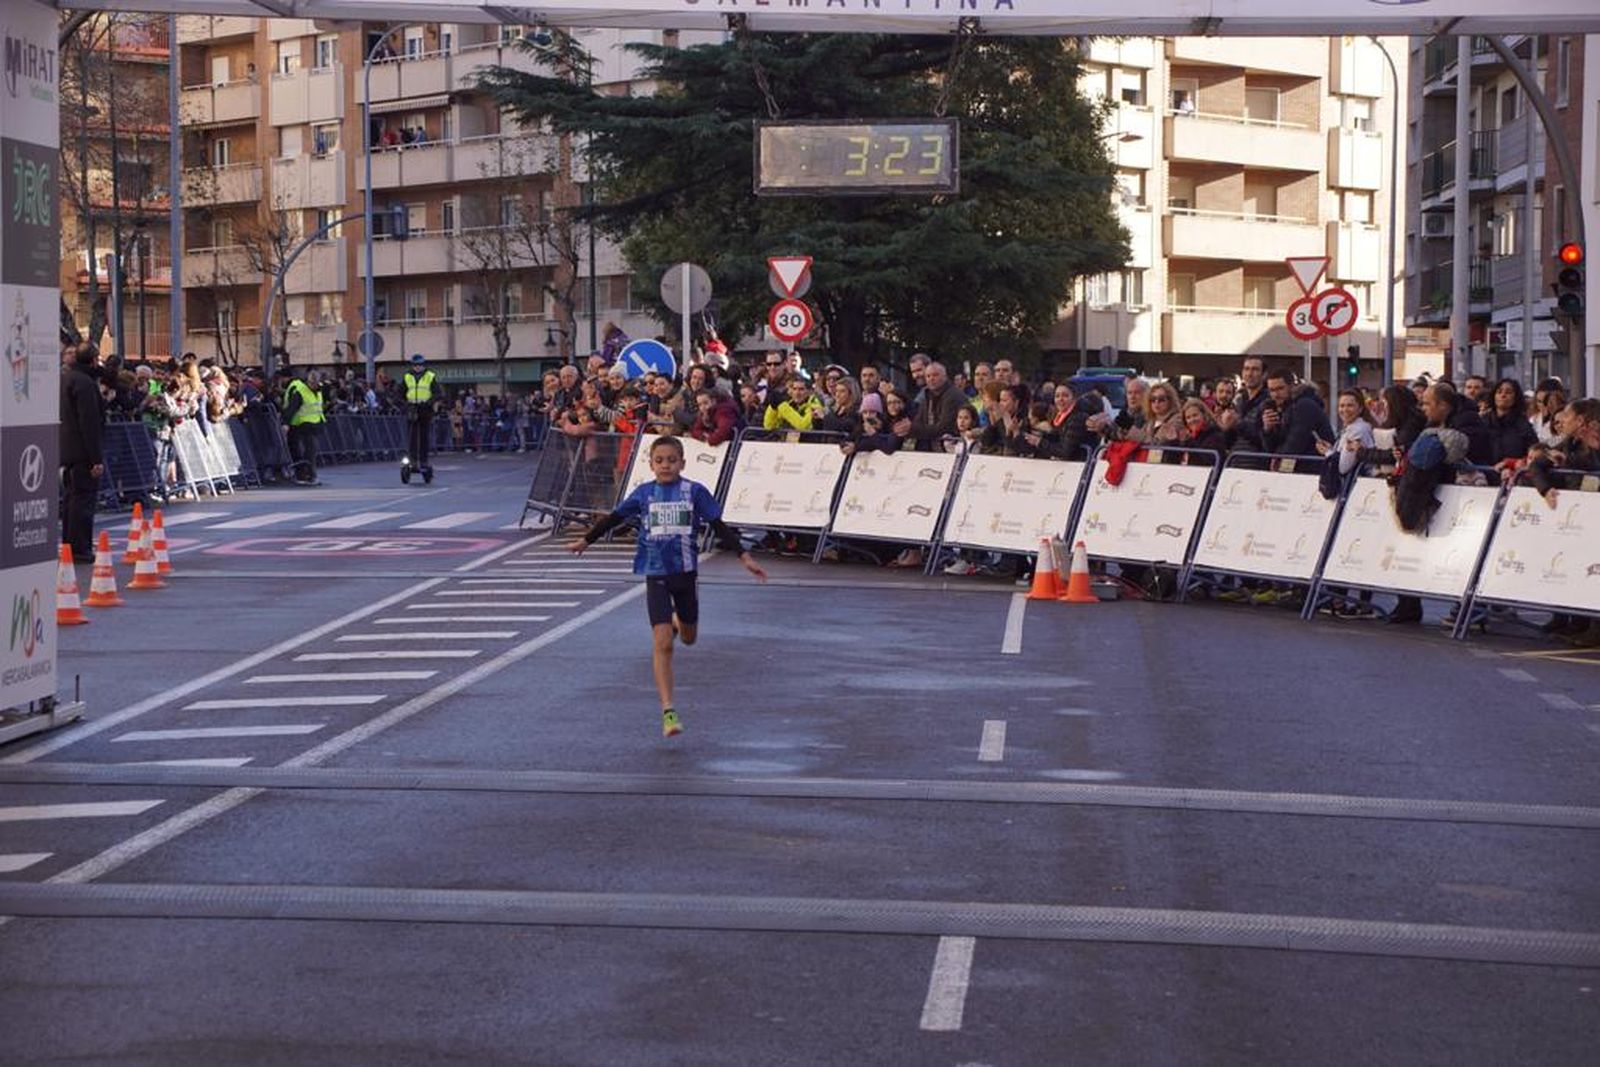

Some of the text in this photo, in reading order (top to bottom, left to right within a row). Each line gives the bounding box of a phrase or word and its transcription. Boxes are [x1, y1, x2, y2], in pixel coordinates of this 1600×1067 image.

[685, 0, 1015, 10] NTINA
[845, 135, 943, 176] 3:23
[779, 314, 802, 327] 30
